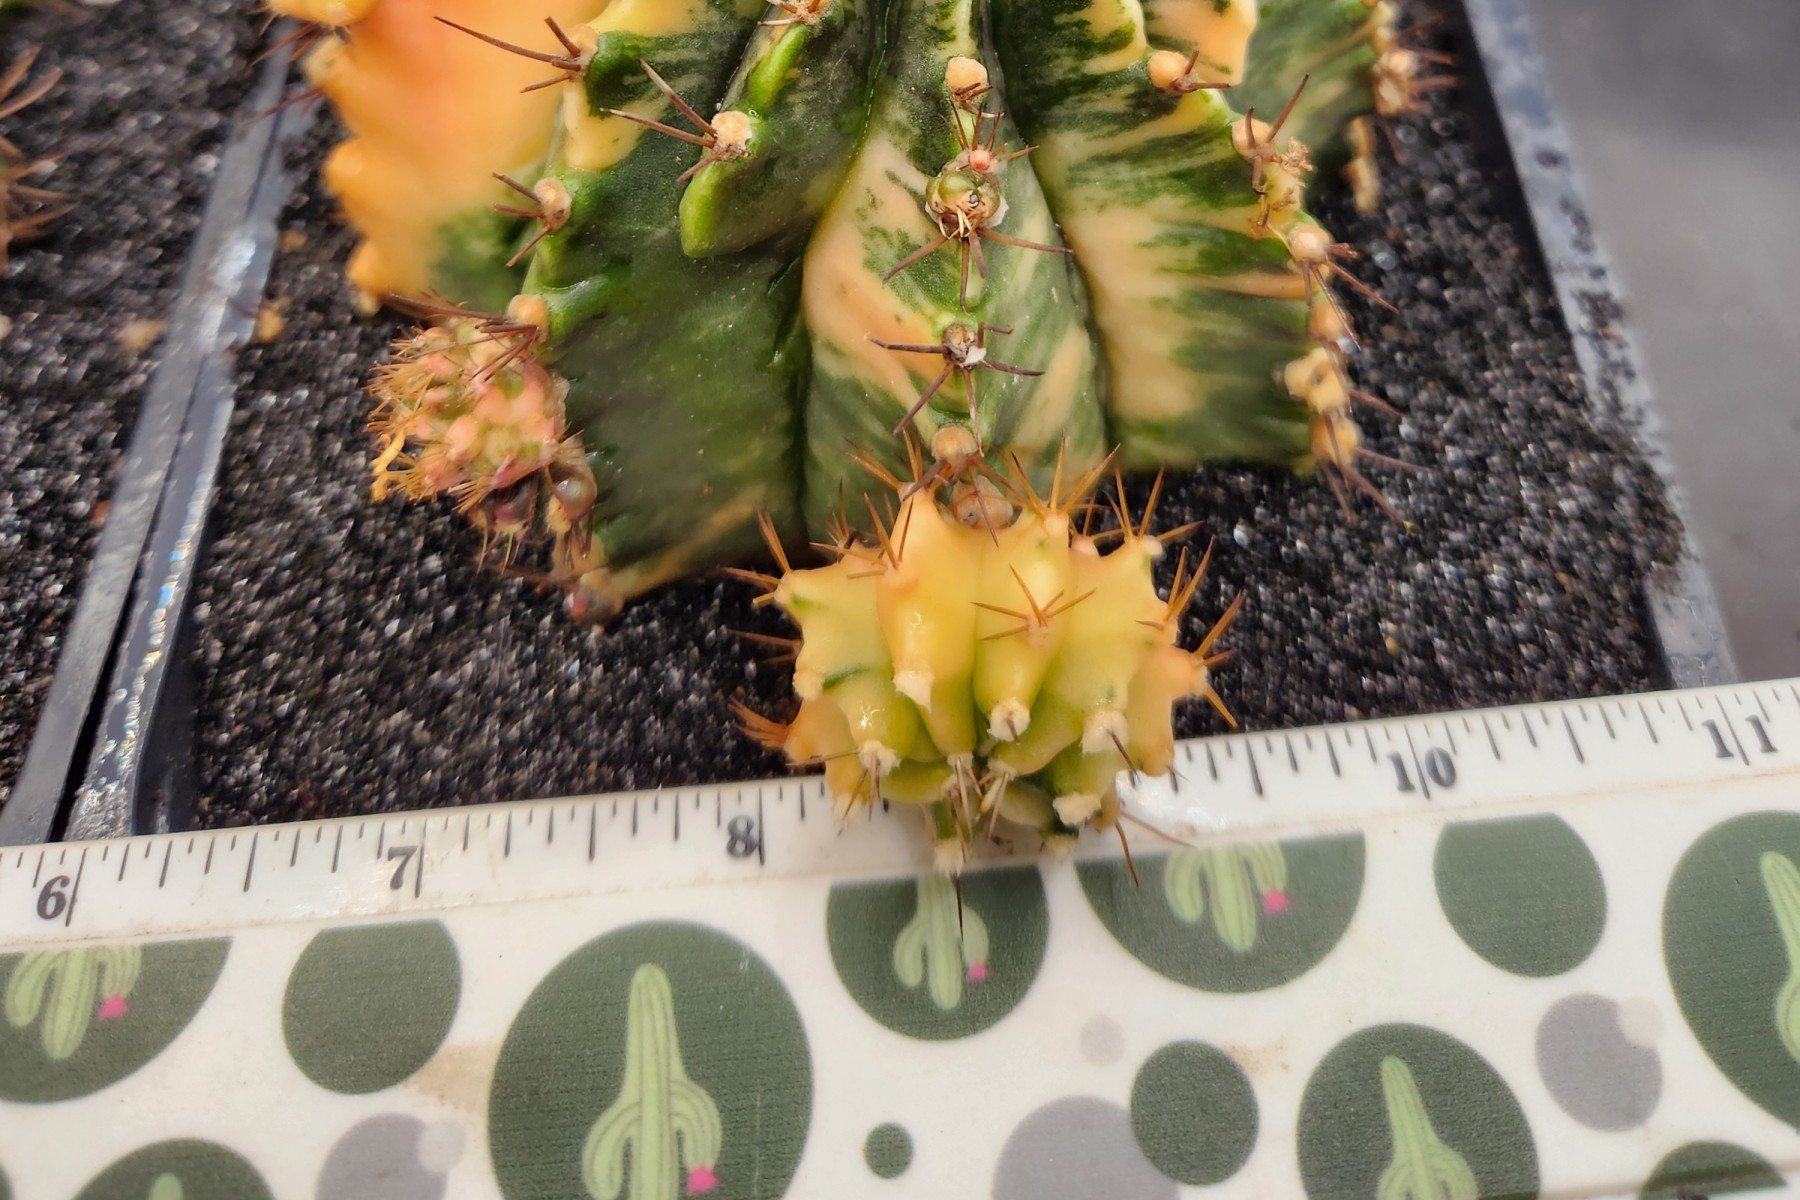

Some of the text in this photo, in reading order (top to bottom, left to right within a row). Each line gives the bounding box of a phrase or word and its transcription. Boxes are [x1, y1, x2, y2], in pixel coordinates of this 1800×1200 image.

[37, 714, 1777, 921] 6 7 8 10 11
